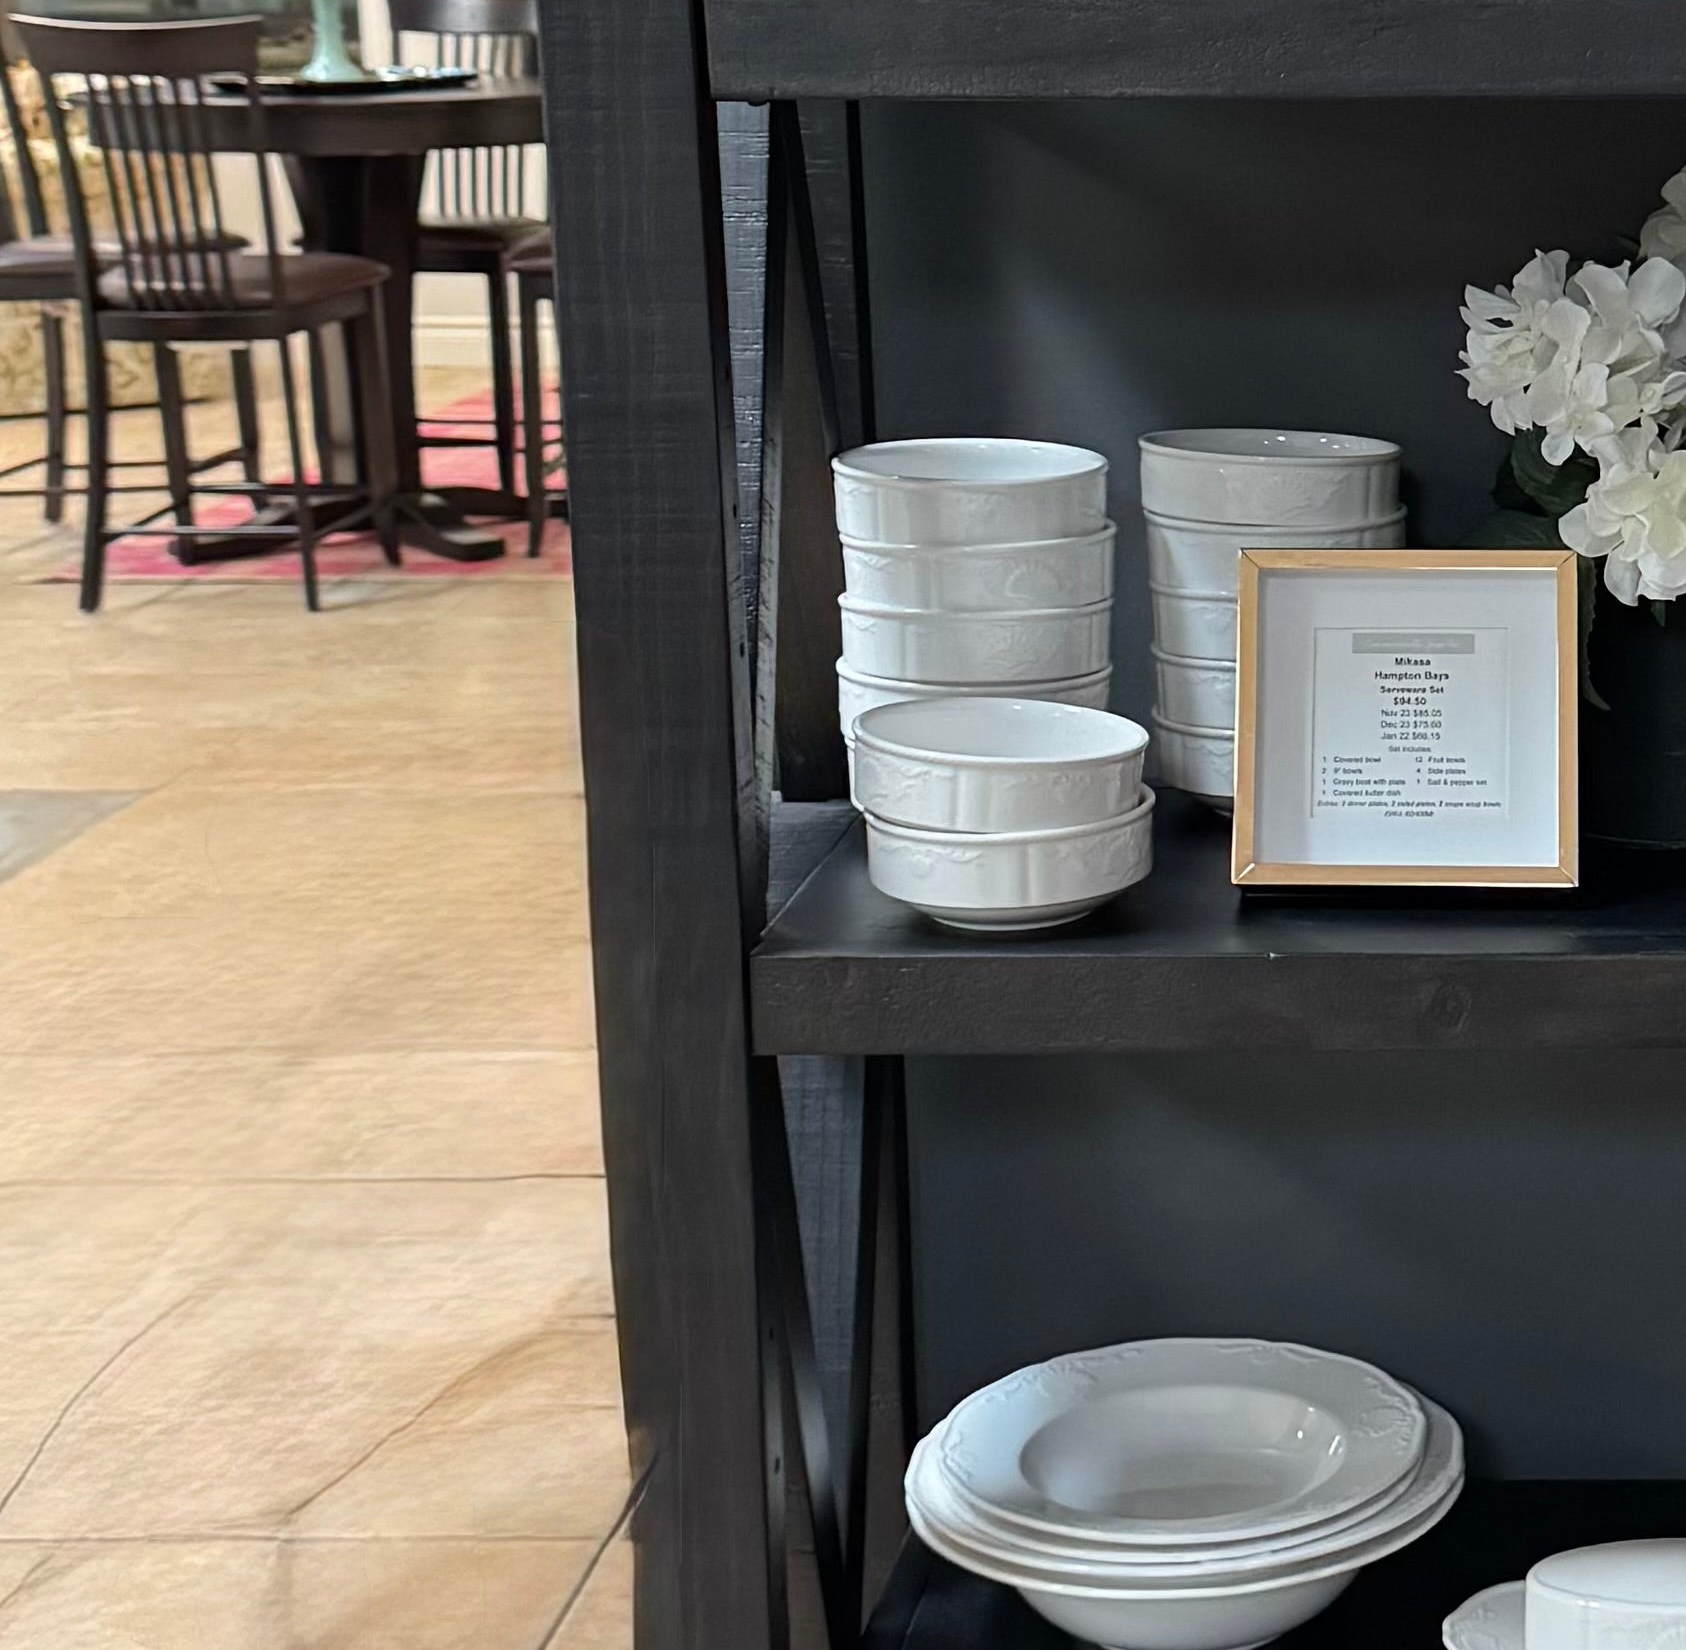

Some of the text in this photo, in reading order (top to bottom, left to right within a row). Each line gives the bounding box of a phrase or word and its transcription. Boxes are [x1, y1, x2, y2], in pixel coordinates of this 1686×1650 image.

[1394, 657, 1431, 666] Mikasa
[1374, 671, 1449, 682] Hampton Bays
[1429, 686, 1444, 694] Set
[1380, 720, 1397, 728] Dec
